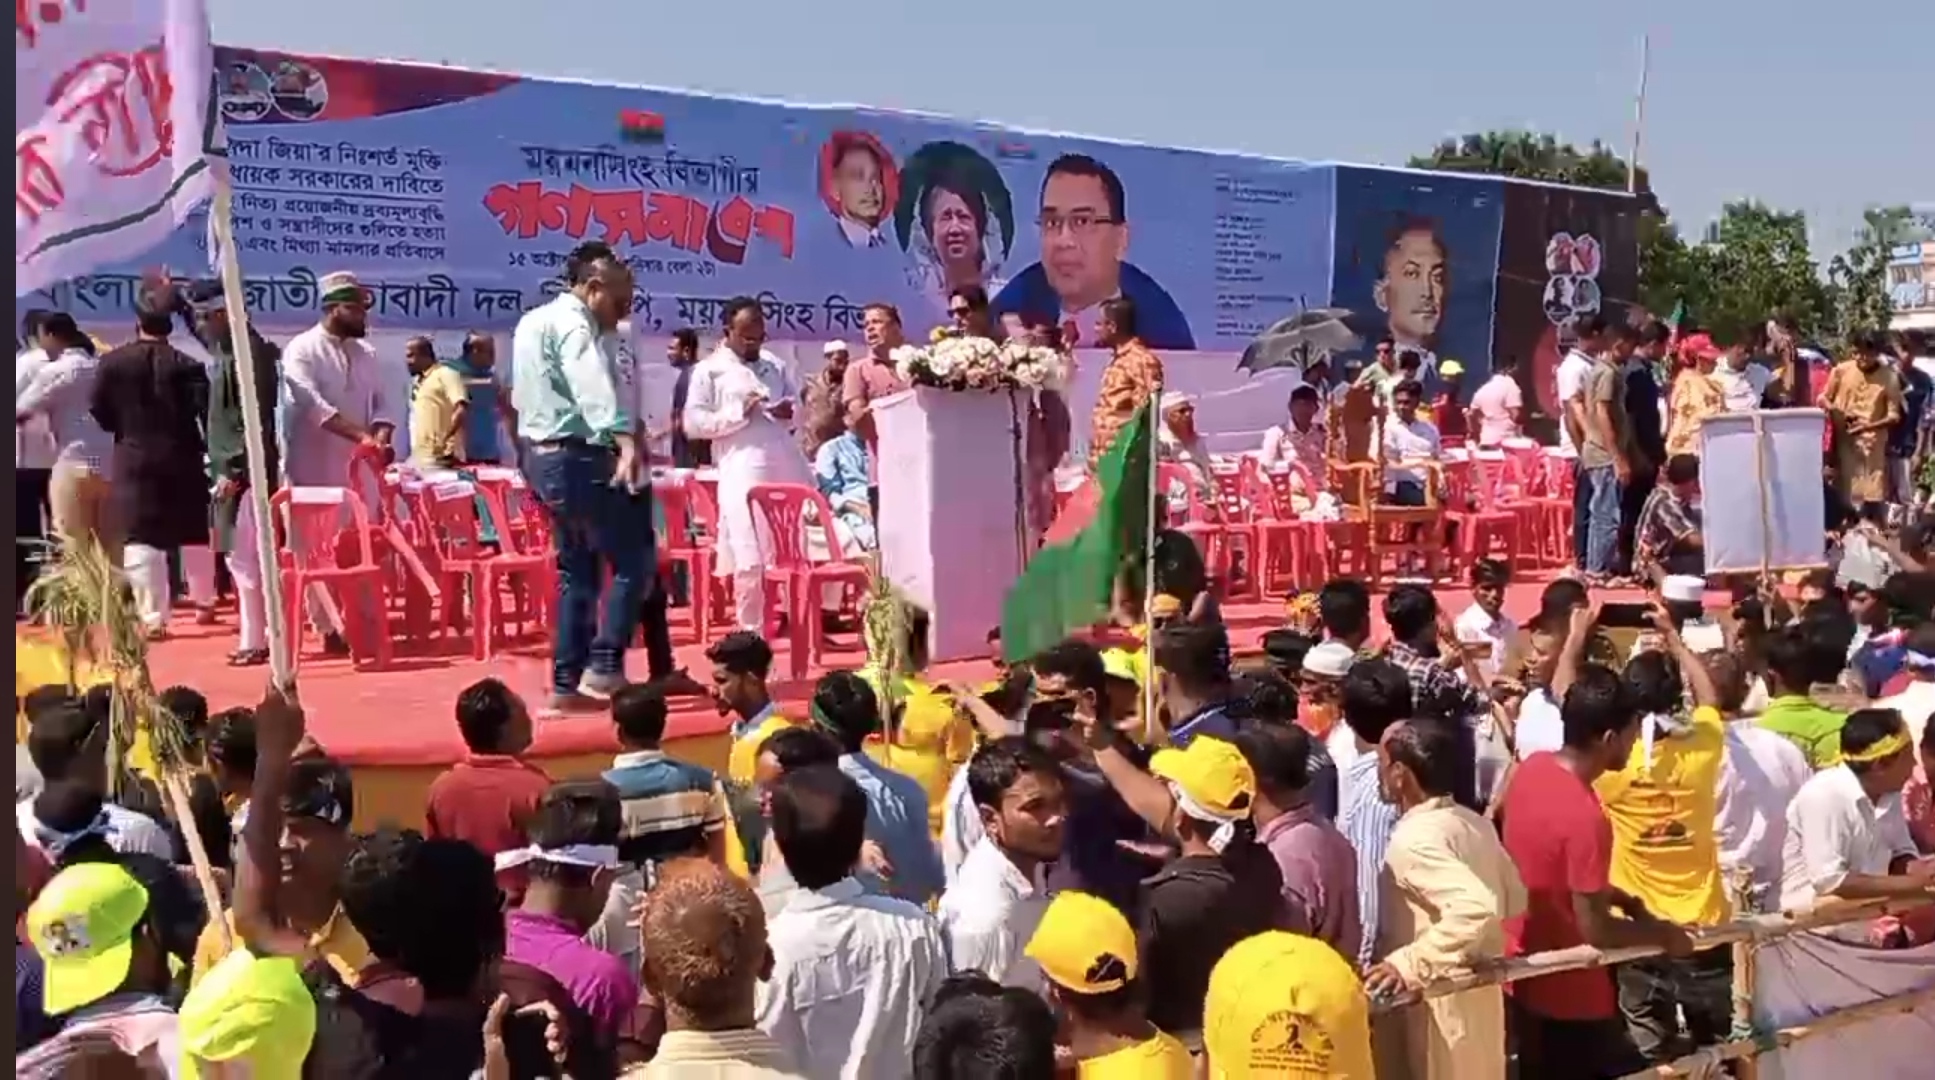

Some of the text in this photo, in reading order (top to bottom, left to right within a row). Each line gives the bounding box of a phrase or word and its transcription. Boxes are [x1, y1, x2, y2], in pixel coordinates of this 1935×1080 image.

[288, 168, 374, 191] সরকারের
[379, 171, 445, 194] দাবিতে
[482, 181, 795, 265] গণসমাবেশ
